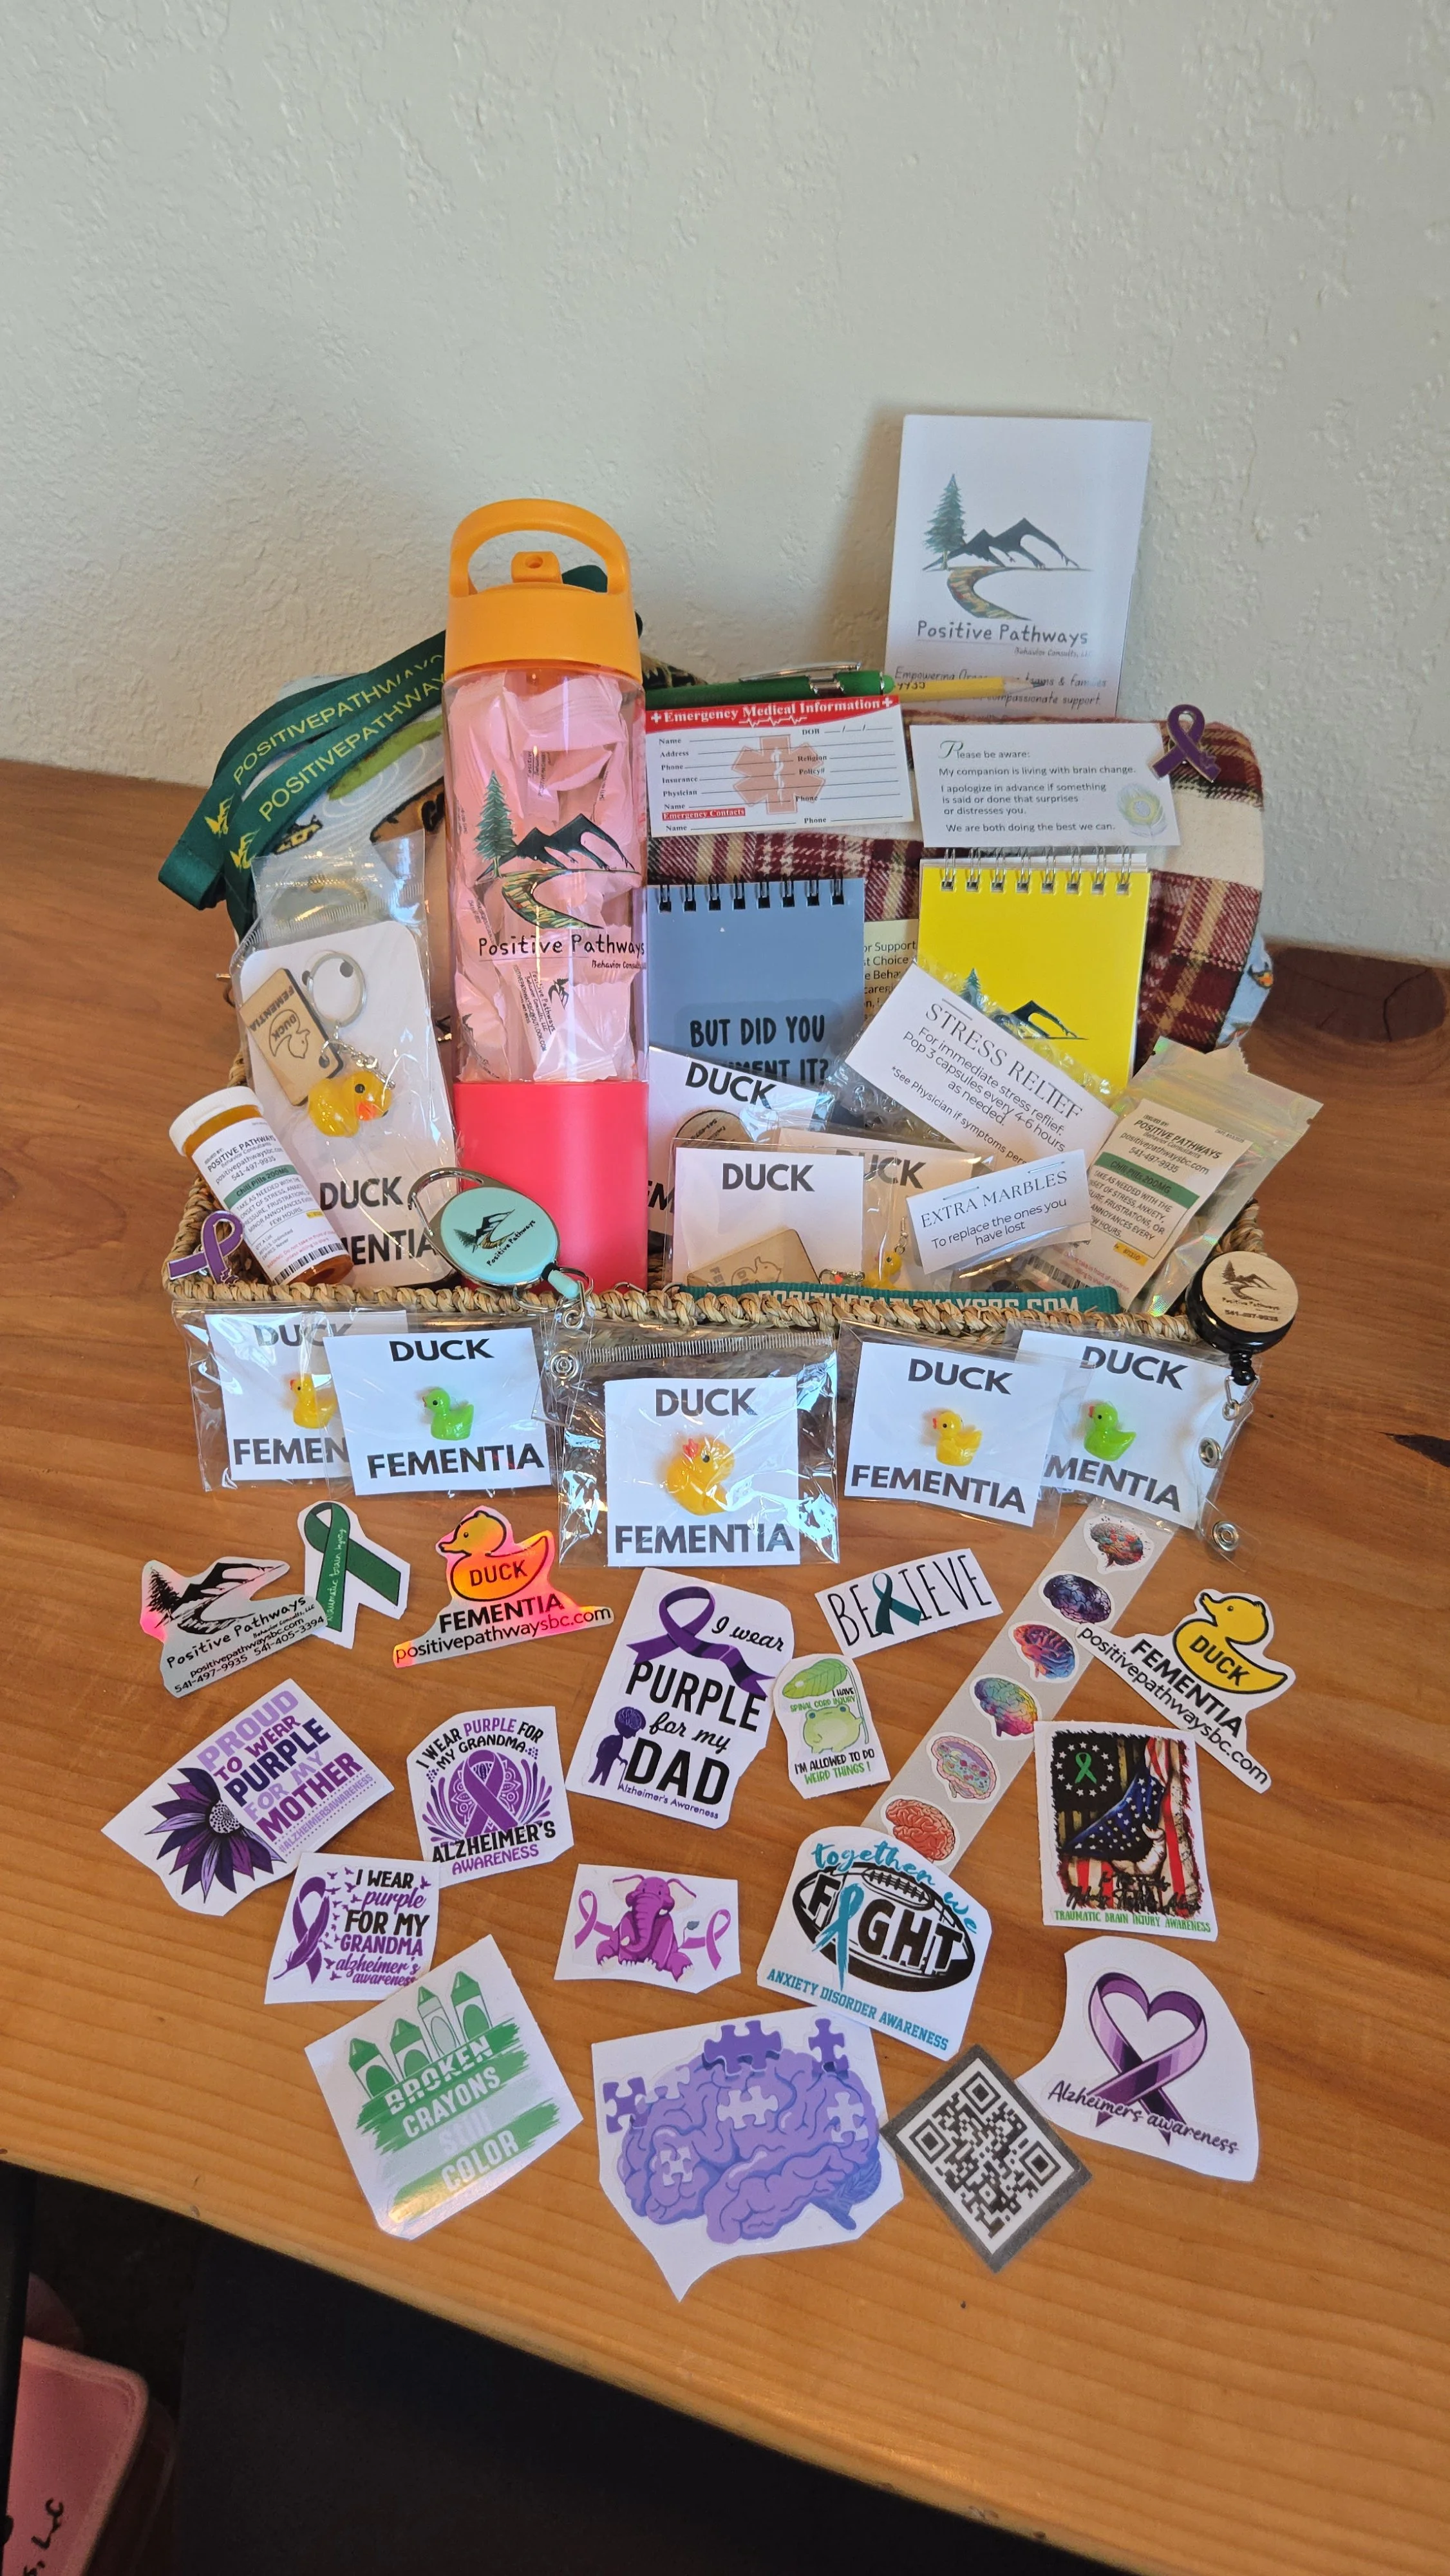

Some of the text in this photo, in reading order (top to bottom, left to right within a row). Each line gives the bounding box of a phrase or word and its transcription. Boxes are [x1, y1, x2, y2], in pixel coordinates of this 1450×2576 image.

[918, 620, 1088, 647] Positive Pathways
[664, 699, 880, 723] Emergency Medical Information
[798, 754, 827, 762] Religion
[938, 740, 981, 760] Please
[984, 750, 996, 759] be
[939, 768, 954, 777] My
[956, 767, 1010, 776] companion
[1021, 766, 1047, 776] living
[1049, 766, 1070, 774] with
[1073, 766, 1097, 774] brain
[1099, 765, 1136, 776] change.
[663, 808, 744, 820] Emergency Contacts
[946, 824, 962, 832] We
[983, 822, 1005, 832] both
[1008, 822, 1035, 833] doing
[1037, 822, 1053, 831] the
[1055, 822, 1077, 831] best
[690, 1014, 825, 1047] BUT DID YOU
[919, 1027, 938, 1045] For
[938, 1040, 999, 1088] immediate
[999, 1085, 1031, 1112] stress
[925, 1003, 1082, 1119] STRESS RELIEF
[903, 1031, 1066, 1152] Pop 3 capsules every 4-6 hours
[948, 1081, 1005, 1126] as needed.
[1134, 1120, 1172, 1140] POSITIVE
[1172, 1135, 1223, 1159] PATHWAYS
[321, 1176, 403, 1210] DUCK
[722, 1163, 815, 1191] DUCK
[921, 1170, 1068, 1228] EXTRA MARBLES
[487, 1219, 536, 1266] Positive Pathways
[932, 1198, 1067, 1249] To replace the ones you
[975, 1221, 1026, 1246] have lost
[389, 1338, 494, 1362] DUCK
[1078, 1346, 1189, 1390] DUCK
[908, 1358, 1013, 1395] DUCK
[655, 1387, 758, 1416] DUCK
[367, 1443, 545, 1479] FEMENTIA
[851, 1465, 1026, 1514] FEMENTIA
[615, 1524, 795, 1553] FEMENTIA
[469, 1560, 528, 1587] DUCK
[167, 1597, 306, 1669] Positive Pathways
[440, 1593, 565, 1633] FEMENTIA
[190, 1618, 304, 1676] positivepathwaysbc.com
[396, 1608, 611, 1663] positivepathwaysbc.com
[711, 1616, 784, 1651] I wear
[174, 1616, 324, 1694] 541-497-9935 541-405-3394
[1189, 1634, 1250, 1687] DUCK
[626, 1660, 767, 1732] PURPLE
[790, 1696, 855, 1712] SPINAL CORD INJURY
[837, 1687, 854, 1696] HAVE
[1077, 1627, 1268, 1785] positivepathwaysbc.com
[1131, 1639, 1243, 1738] FEMENTIA
[197, 1690, 299, 1772] PROUD
[213, 1715, 301, 1781] TO WEAR
[416, 1718, 544, 1769] I WEAR PURPLE FOR
[650, 1712, 731, 1754] for my
[224, 1718, 331, 1807] PURPLE
[437, 1734, 526, 1770] MY GRANDMA
[624, 1738, 730, 1805] DAD
[795, 1748, 874, 1774] I'M ALLOWED TO DO
[243, 1751, 324, 1821] FOR MY
[804, 1763, 865, 1785] WEIRD THINGS
[256, 1752, 363, 1842] MOTHER
[617, 1783, 719, 1819] Alzheimer's Awareness
[432, 1821, 556, 1863] ALZHEIMER'S
[453, 1844, 539, 1875] AWARENESS
[356, 1869, 414, 1888] I WEAR
[361, 1887, 428, 1914] purple
[944, 1891, 977, 1935] we
[344, 1909, 430, 1937] FOR MY
[1054, 1910, 1211, 1932] TRAUMATIC BRAIN INJURY AWARENESS
[340, 1933, 424, 1956] GRANDMA
[335, 1953, 421, 1977] alzheimer's
[767, 1968, 949, 2051] ANXIETY DISORDER AWARENESS
[386, 2034, 494, 2116] BROKEN
[402, 2065, 501, 2139] CRAYONS
[1048, 2080, 1239, 2154] Alzheimers awareness
[441, 2129, 520, 2190] COLOR
